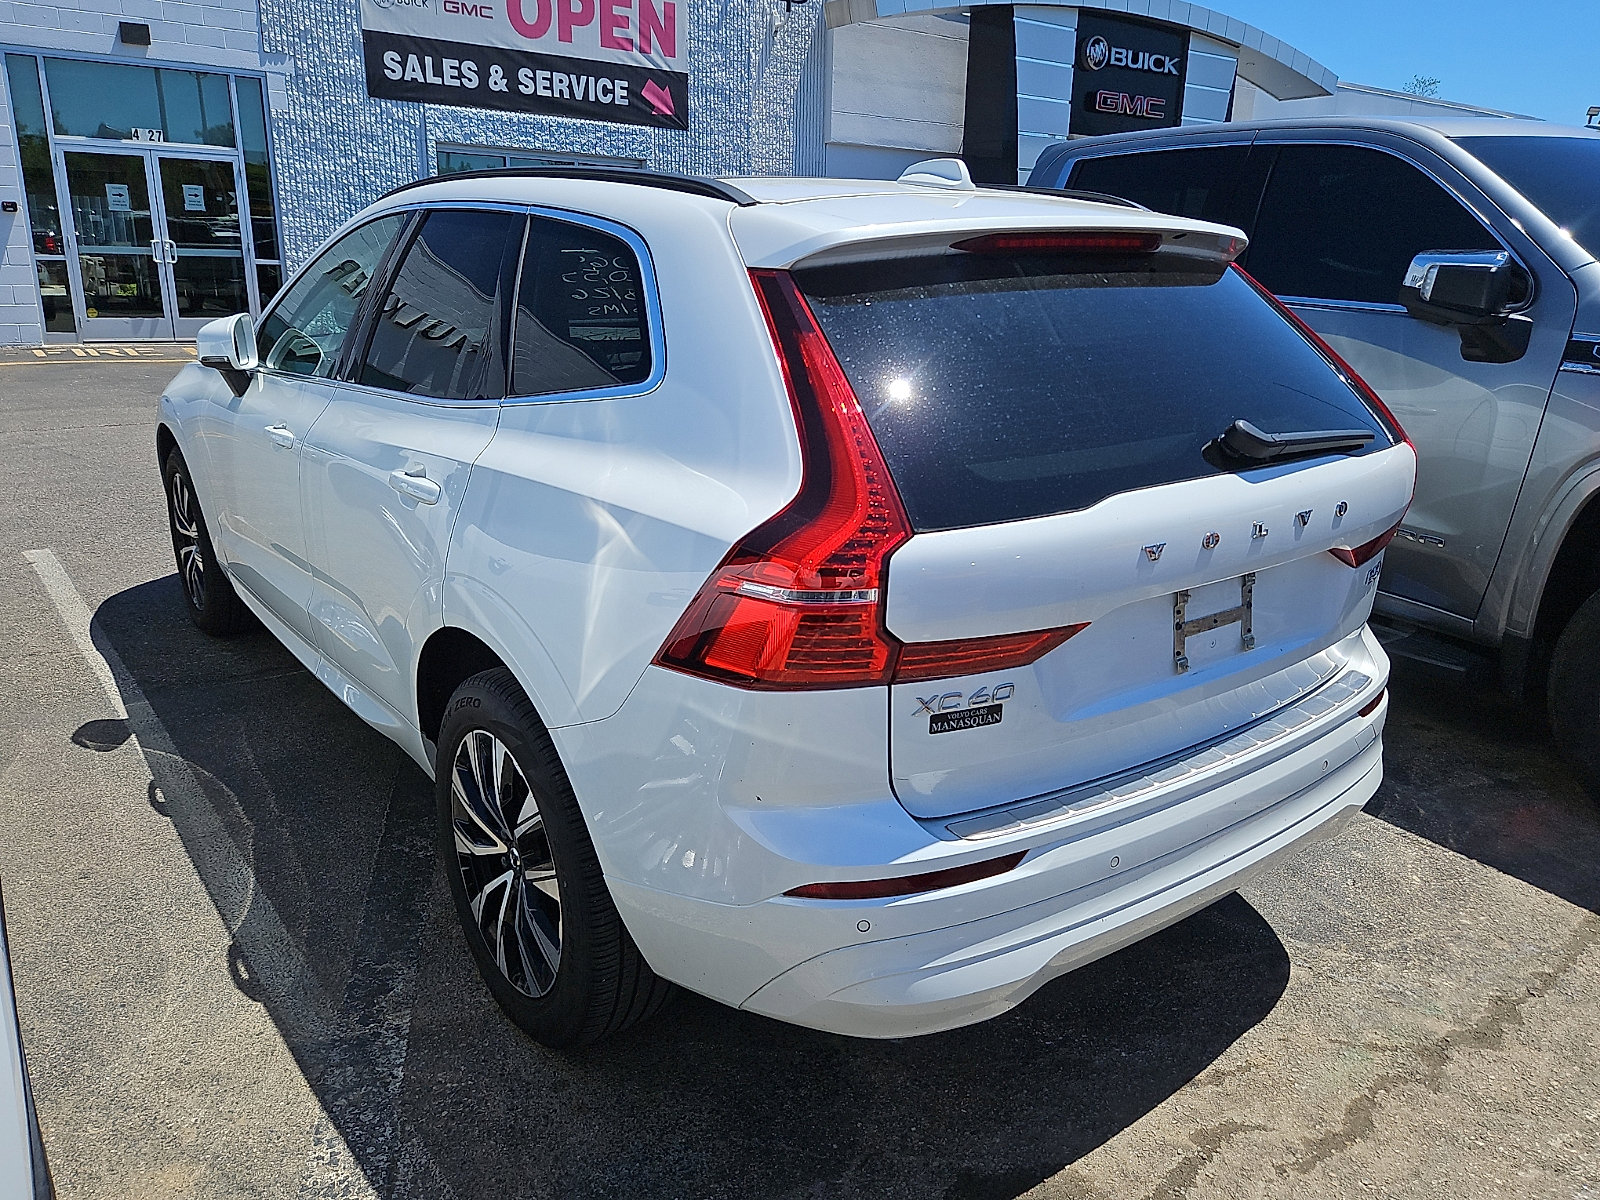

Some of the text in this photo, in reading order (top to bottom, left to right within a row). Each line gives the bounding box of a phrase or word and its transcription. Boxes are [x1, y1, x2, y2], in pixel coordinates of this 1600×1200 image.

[443, 0, 493, 19] GMC
[506, 0, 677, 58] OPEN
[1110, 46, 1180, 76] BUICK
[383, 51, 629, 106] SALES & SERVICE
[1096, 90, 1165, 118] GMC
[32, 347, 163, 358] FIRE
[1141, 500, 1348, 562] VOLVO
[455, 696, 481, 711] ZERO
[911, 682, 1015, 717] XC60
[947, 707, 988, 720] VOLVO CARS
[931, 712, 1001, 732] MANASQUAN
